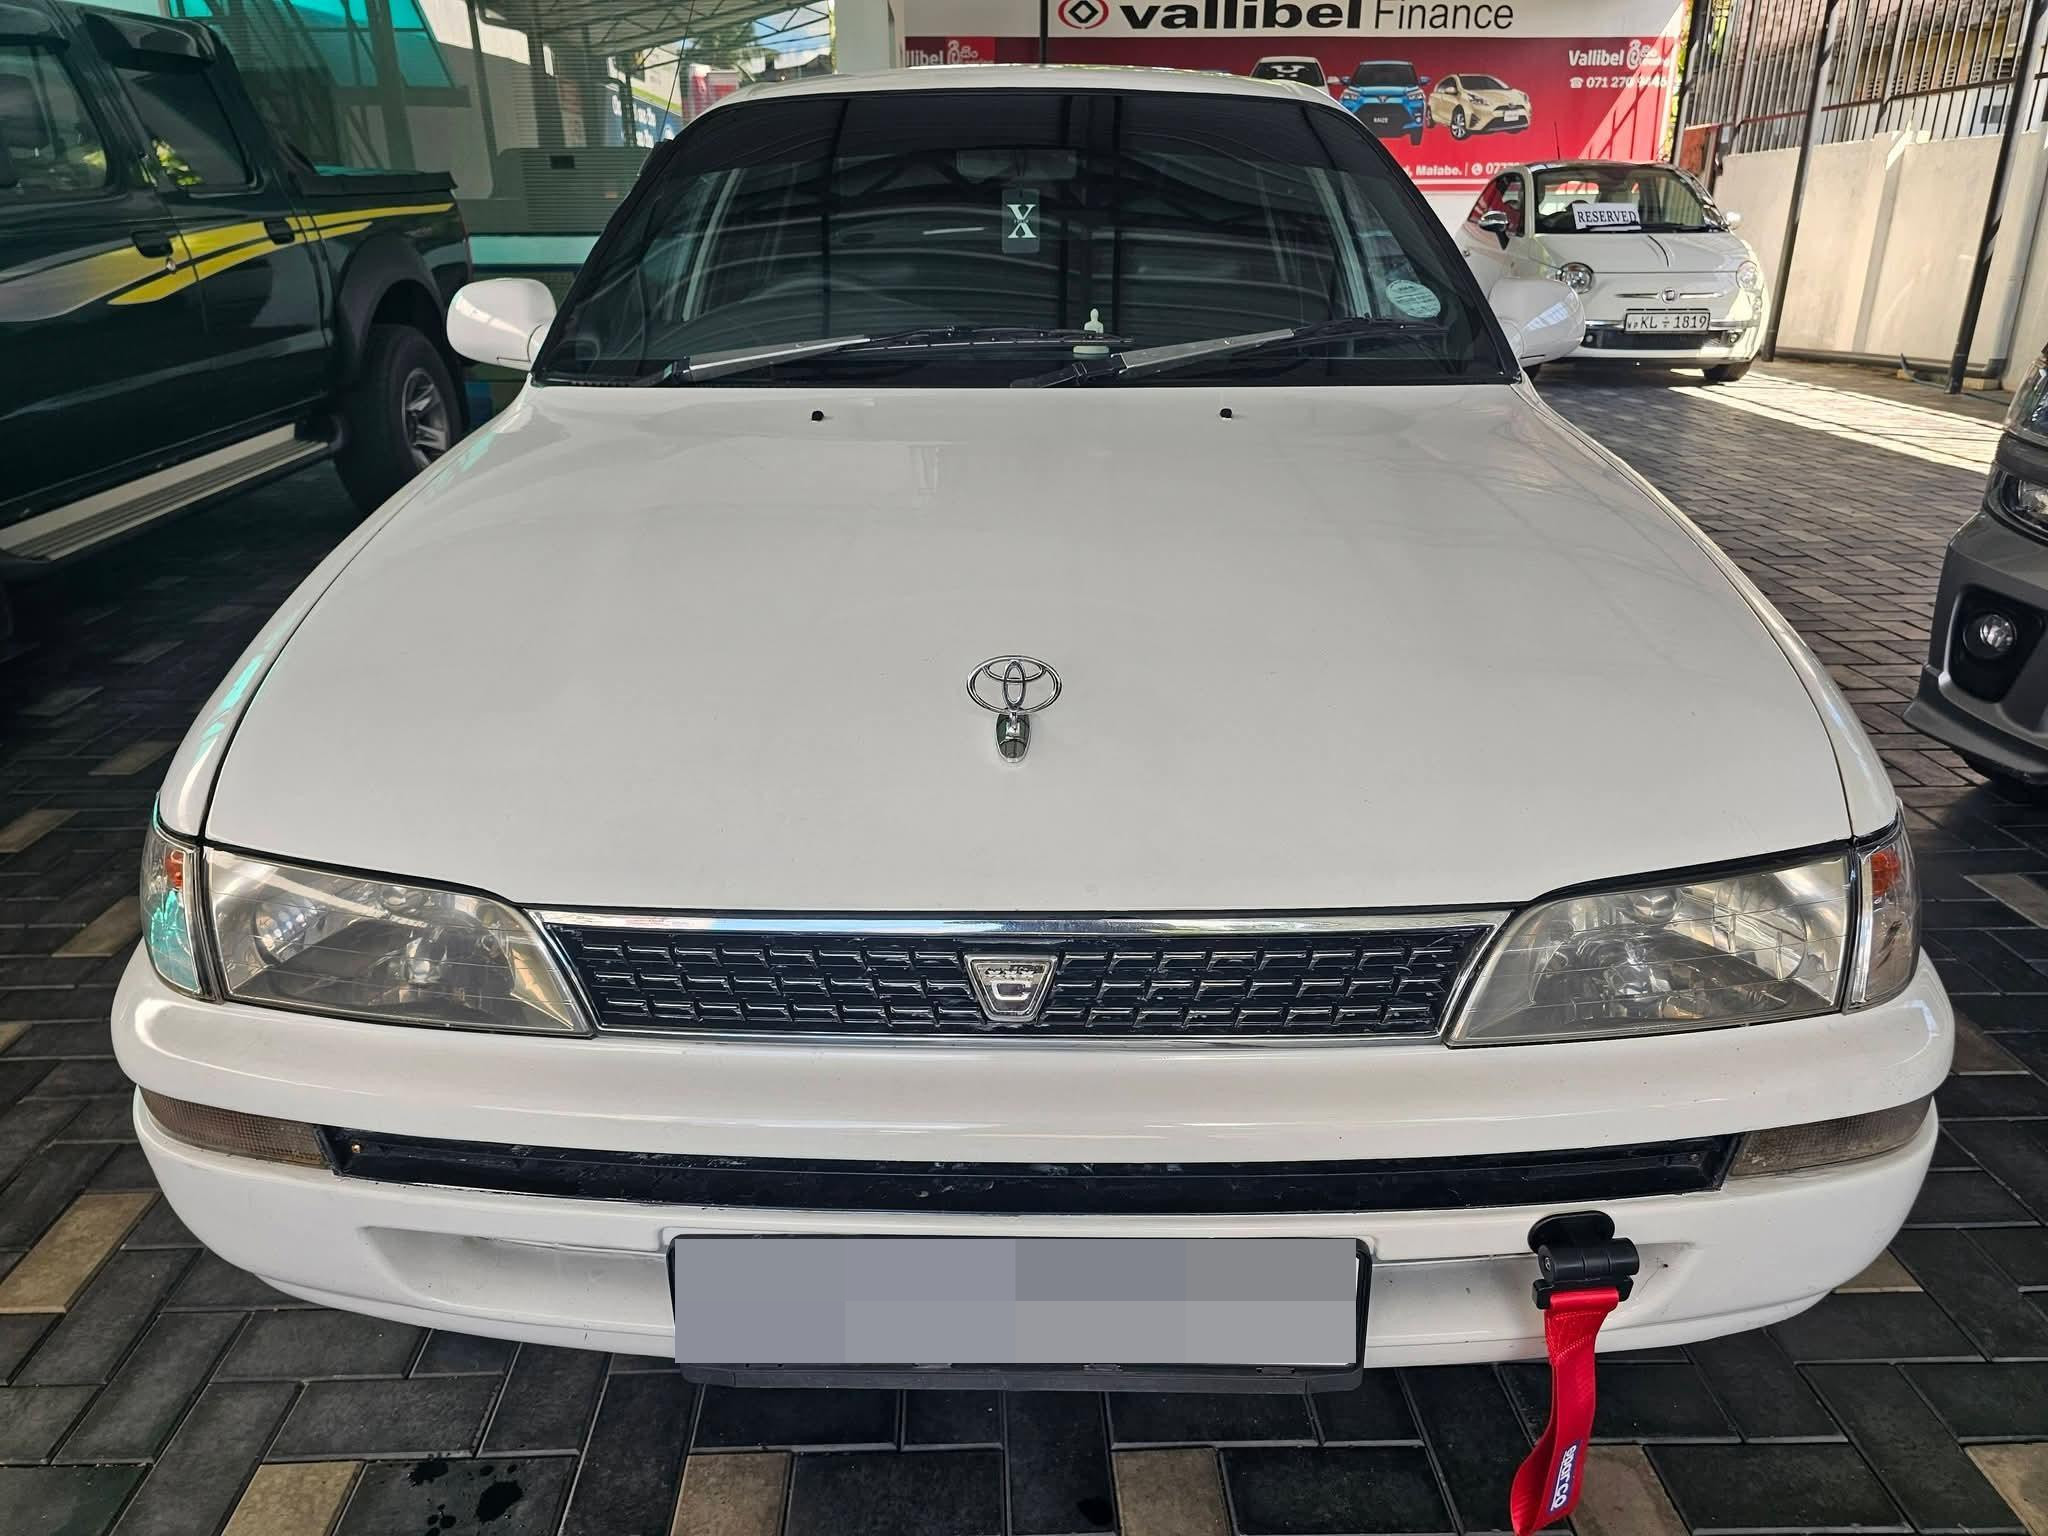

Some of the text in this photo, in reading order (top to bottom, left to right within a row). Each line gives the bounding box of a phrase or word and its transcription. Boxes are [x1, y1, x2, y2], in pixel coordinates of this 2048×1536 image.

[1119, 0, 1514, 29] vallibel Finance
[1568, 49, 1625, 66] Vallibel
[1586, 76, 1609, 88] 071
[1577, 210, 1637, 223] RESERVED
